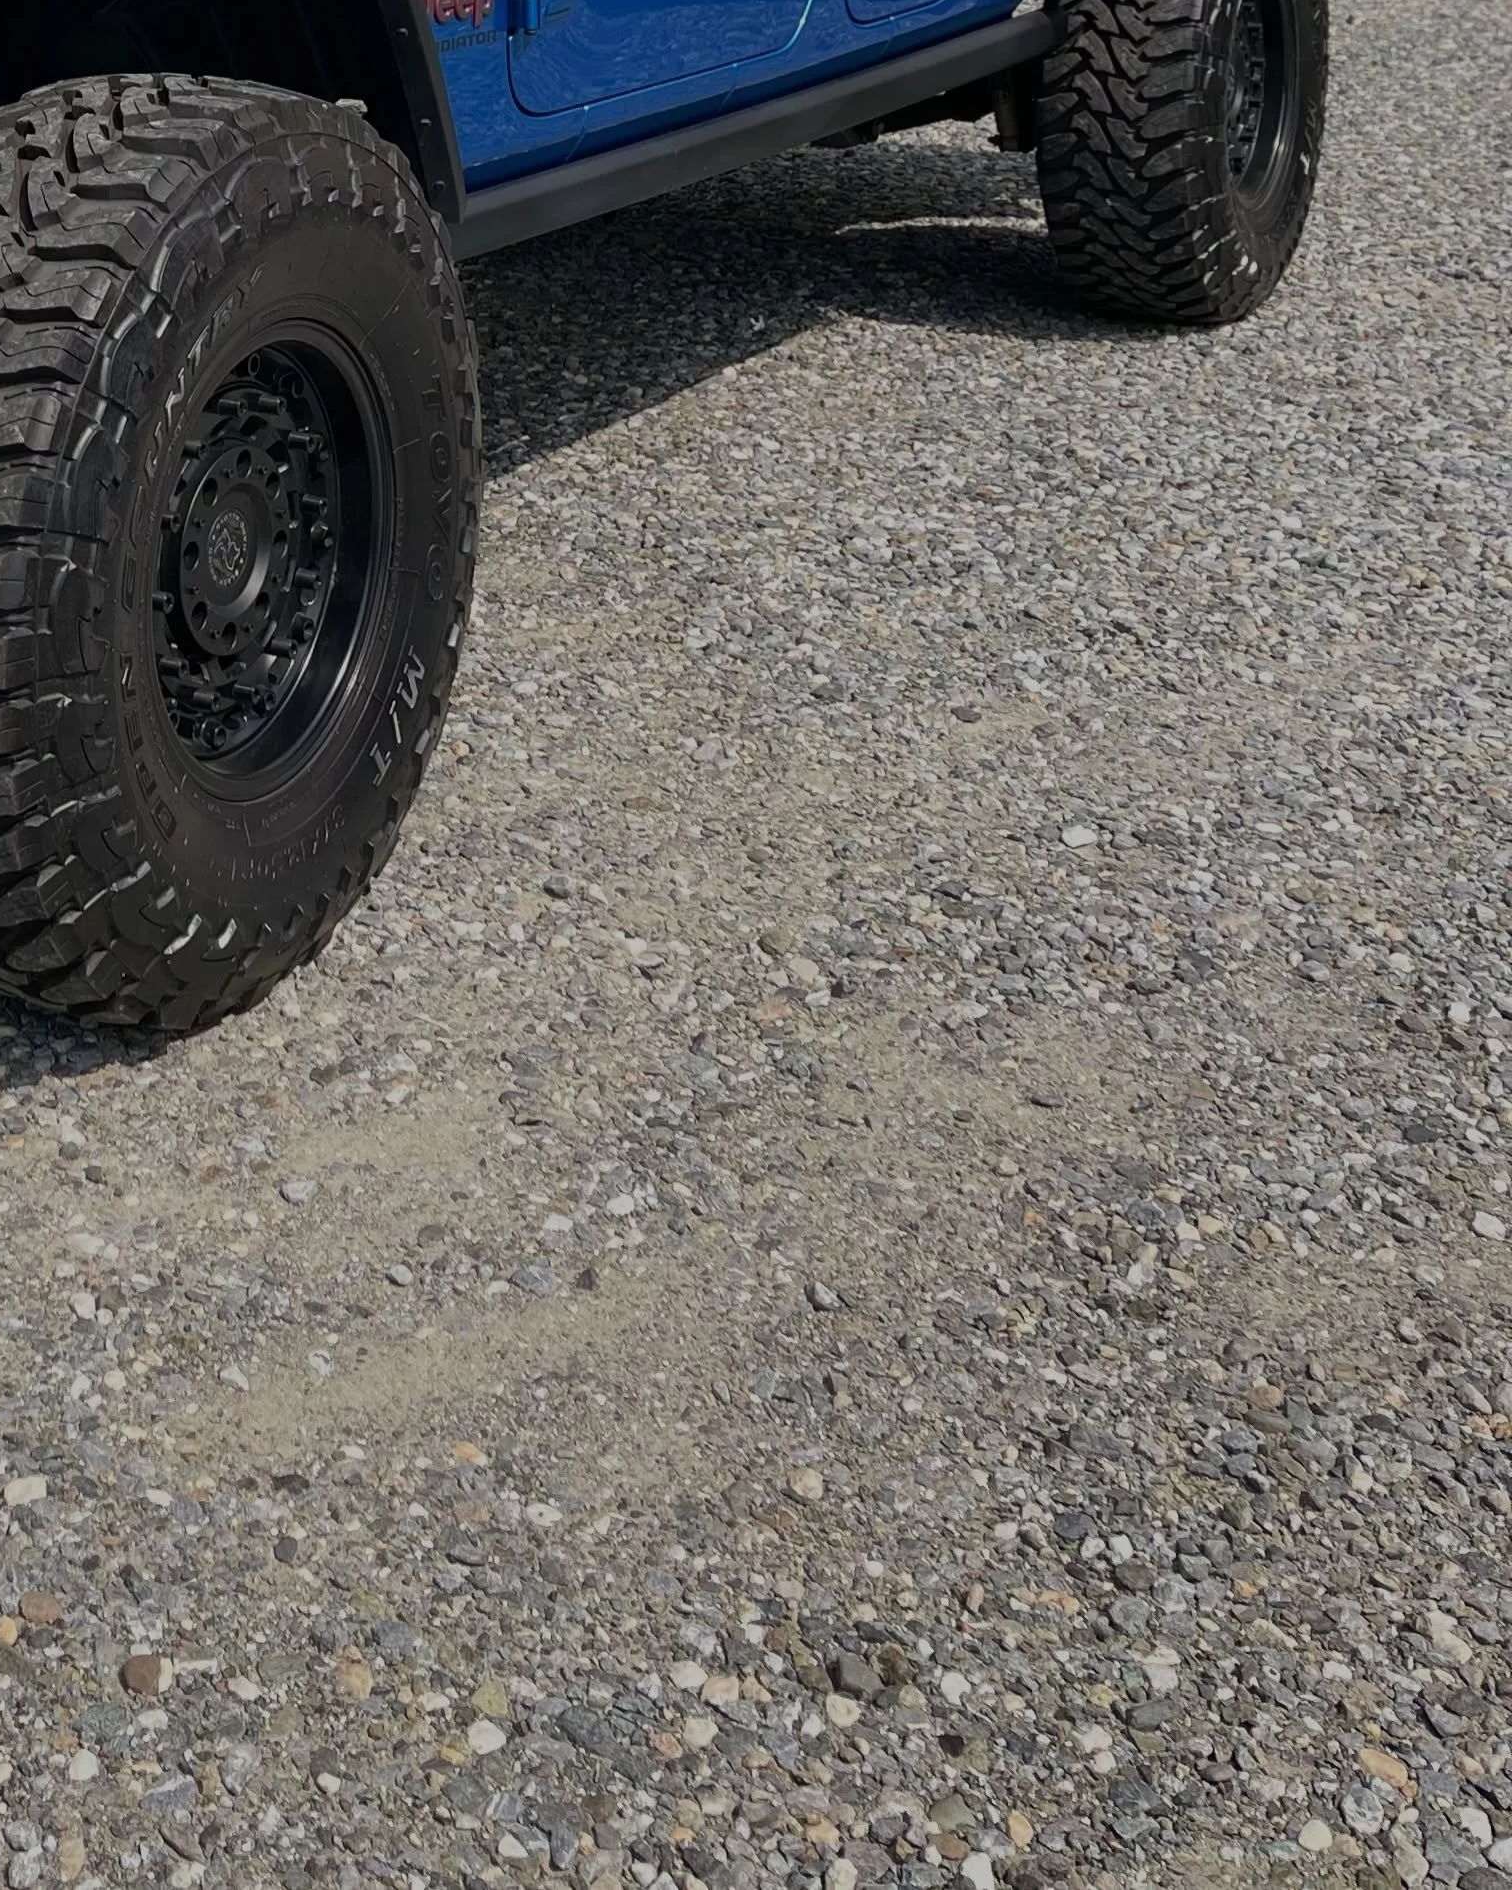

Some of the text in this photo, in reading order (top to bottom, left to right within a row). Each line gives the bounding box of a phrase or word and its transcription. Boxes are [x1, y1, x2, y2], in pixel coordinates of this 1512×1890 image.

[437, 29, 497, 53] DIATOR
[119, 262, 265, 843] OPEN COUNTRY
[421, 373, 454, 602] TOYO
[369, 644, 426, 788] M/T
